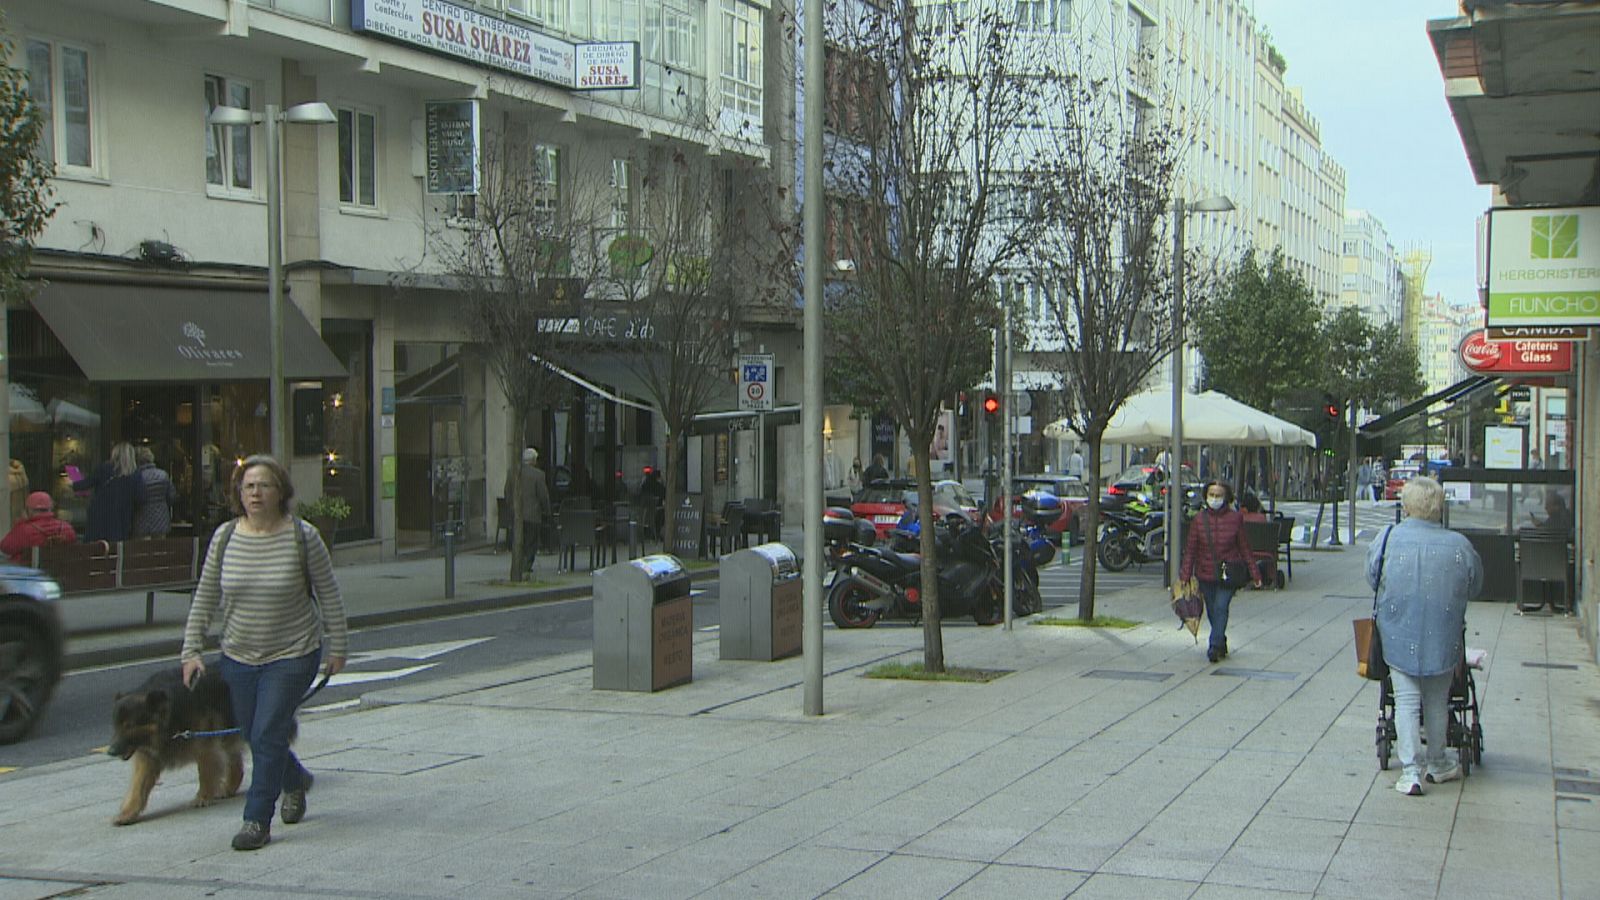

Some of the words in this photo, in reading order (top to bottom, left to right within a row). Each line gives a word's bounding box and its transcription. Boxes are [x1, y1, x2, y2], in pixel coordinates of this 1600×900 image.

[421, 0, 461, 19] CENTRO
[464, 11, 476, 23] DE
[398, 29, 409, 39] DE
[422, 11, 467, 46] SUSA
[471, 26, 532, 65] SUAREZ
[589, 65, 620, 75] SUSA
[580, 76, 629, 86] SUAREZ
[178, 345, 244, 360] Olivares
[1521, 352, 1552, 363] Glass
